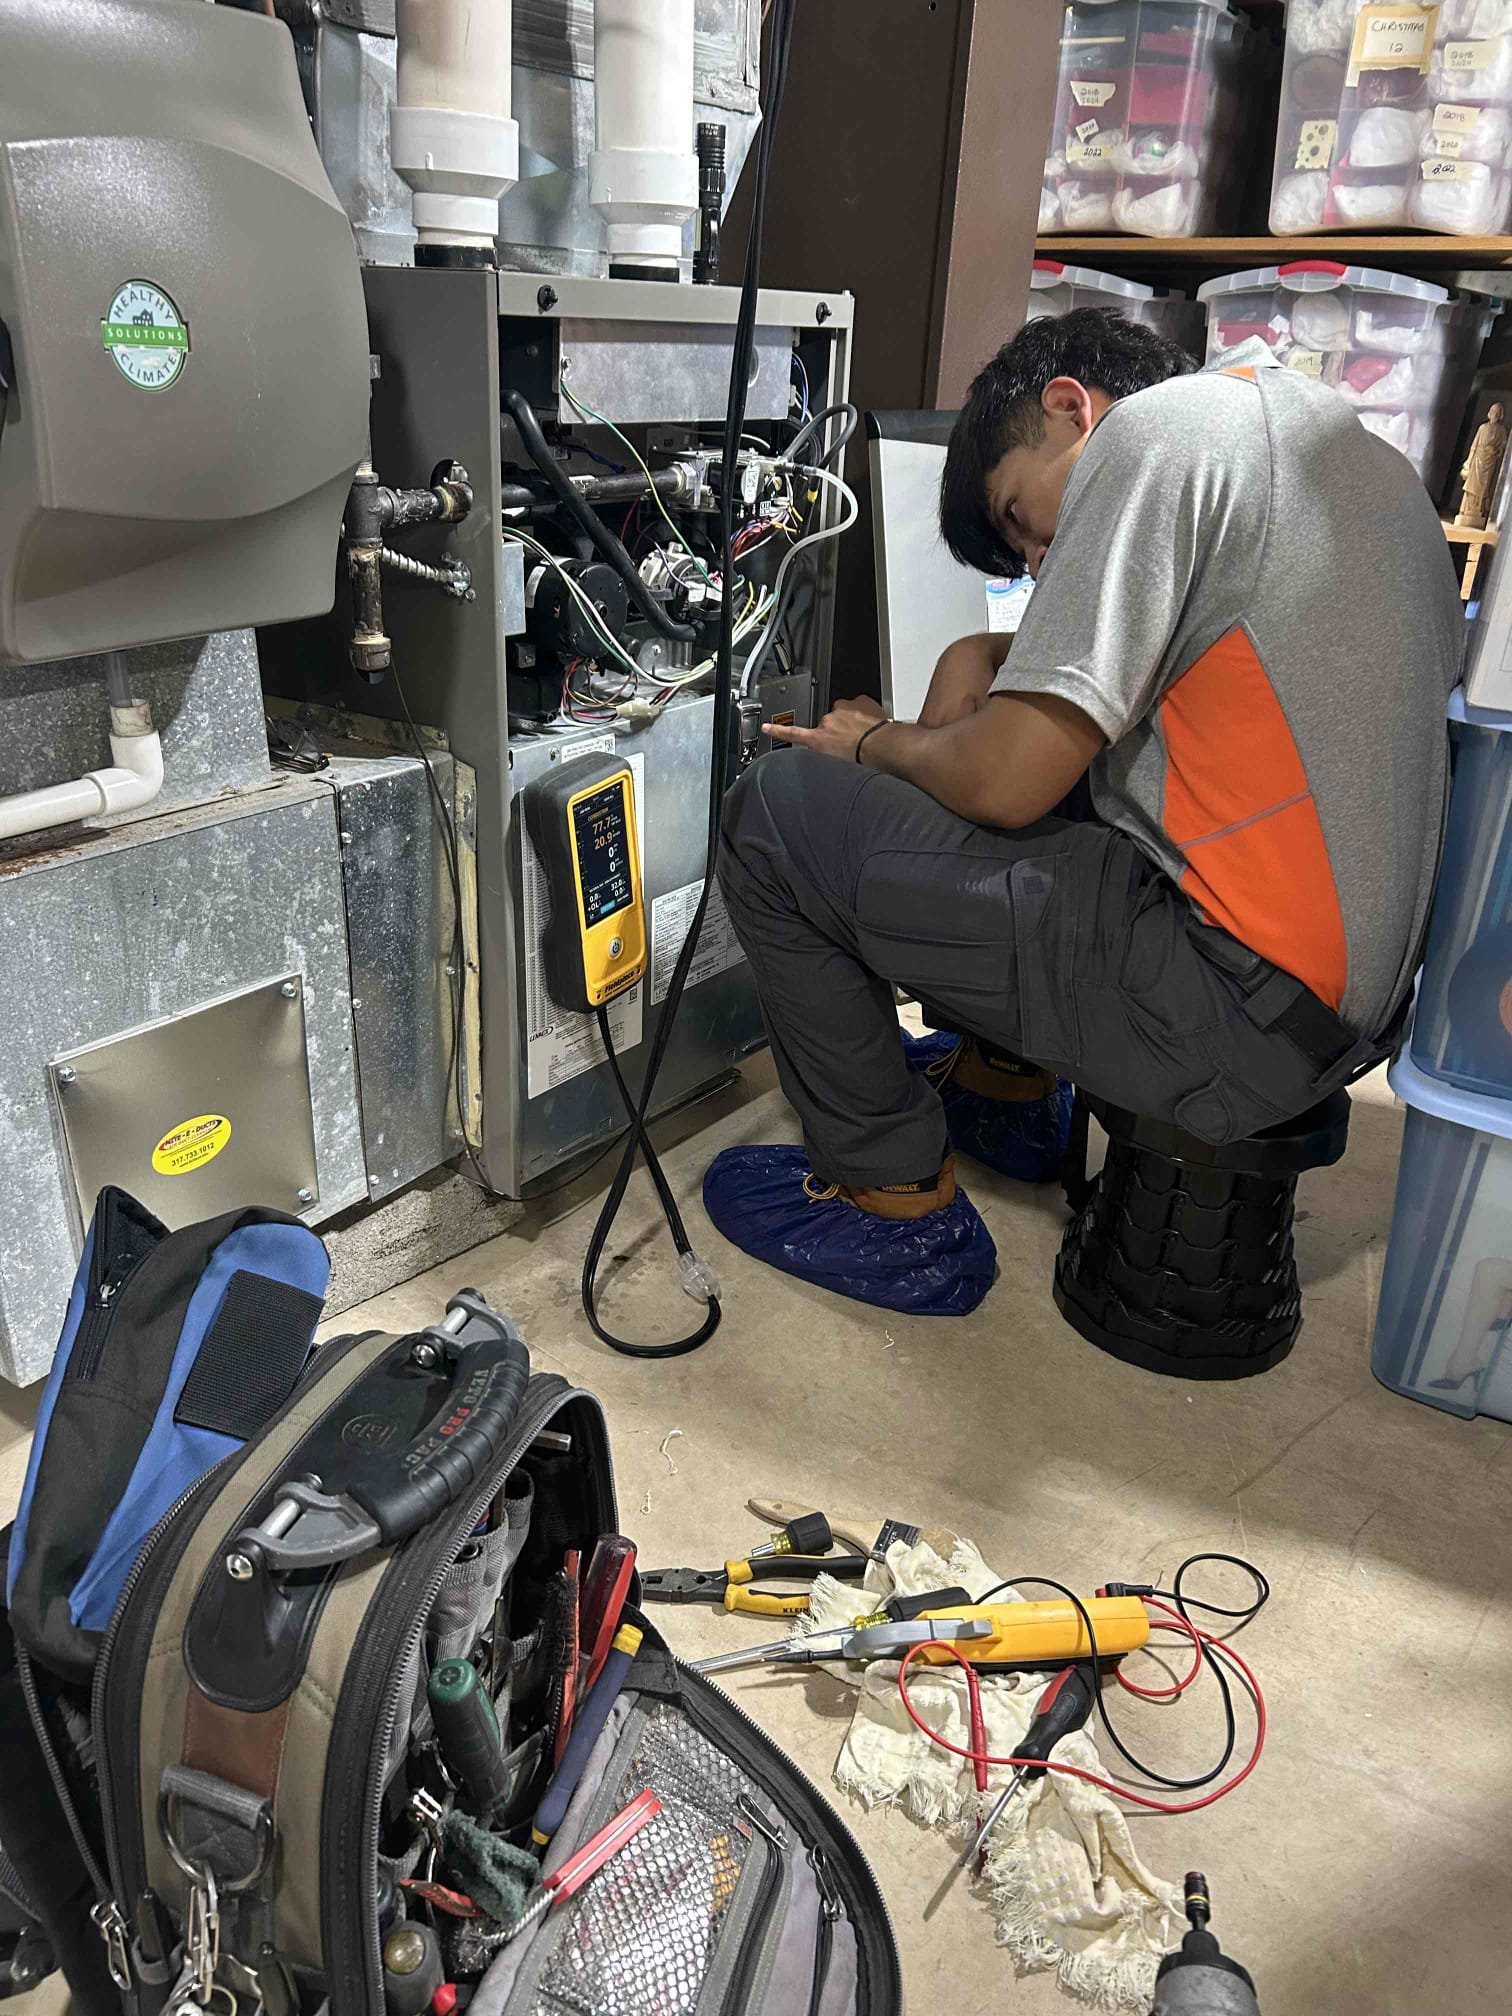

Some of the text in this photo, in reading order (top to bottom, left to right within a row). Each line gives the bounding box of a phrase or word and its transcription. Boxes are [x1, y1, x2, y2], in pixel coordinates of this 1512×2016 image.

[113, 288, 174, 320] HEALTHY
[107, 328, 183, 341] SOLUTIONS
[120, 352, 177, 383] CLIMATE
[592, 815, 611, 835] 77.7
[594, 831, 613, 850] 20.9
[171, 1142, 215, 1167] 317.733.1012
[439, 1407, 471, 1436] PRO
[782, 1606, 810, 1614] KLEIN
